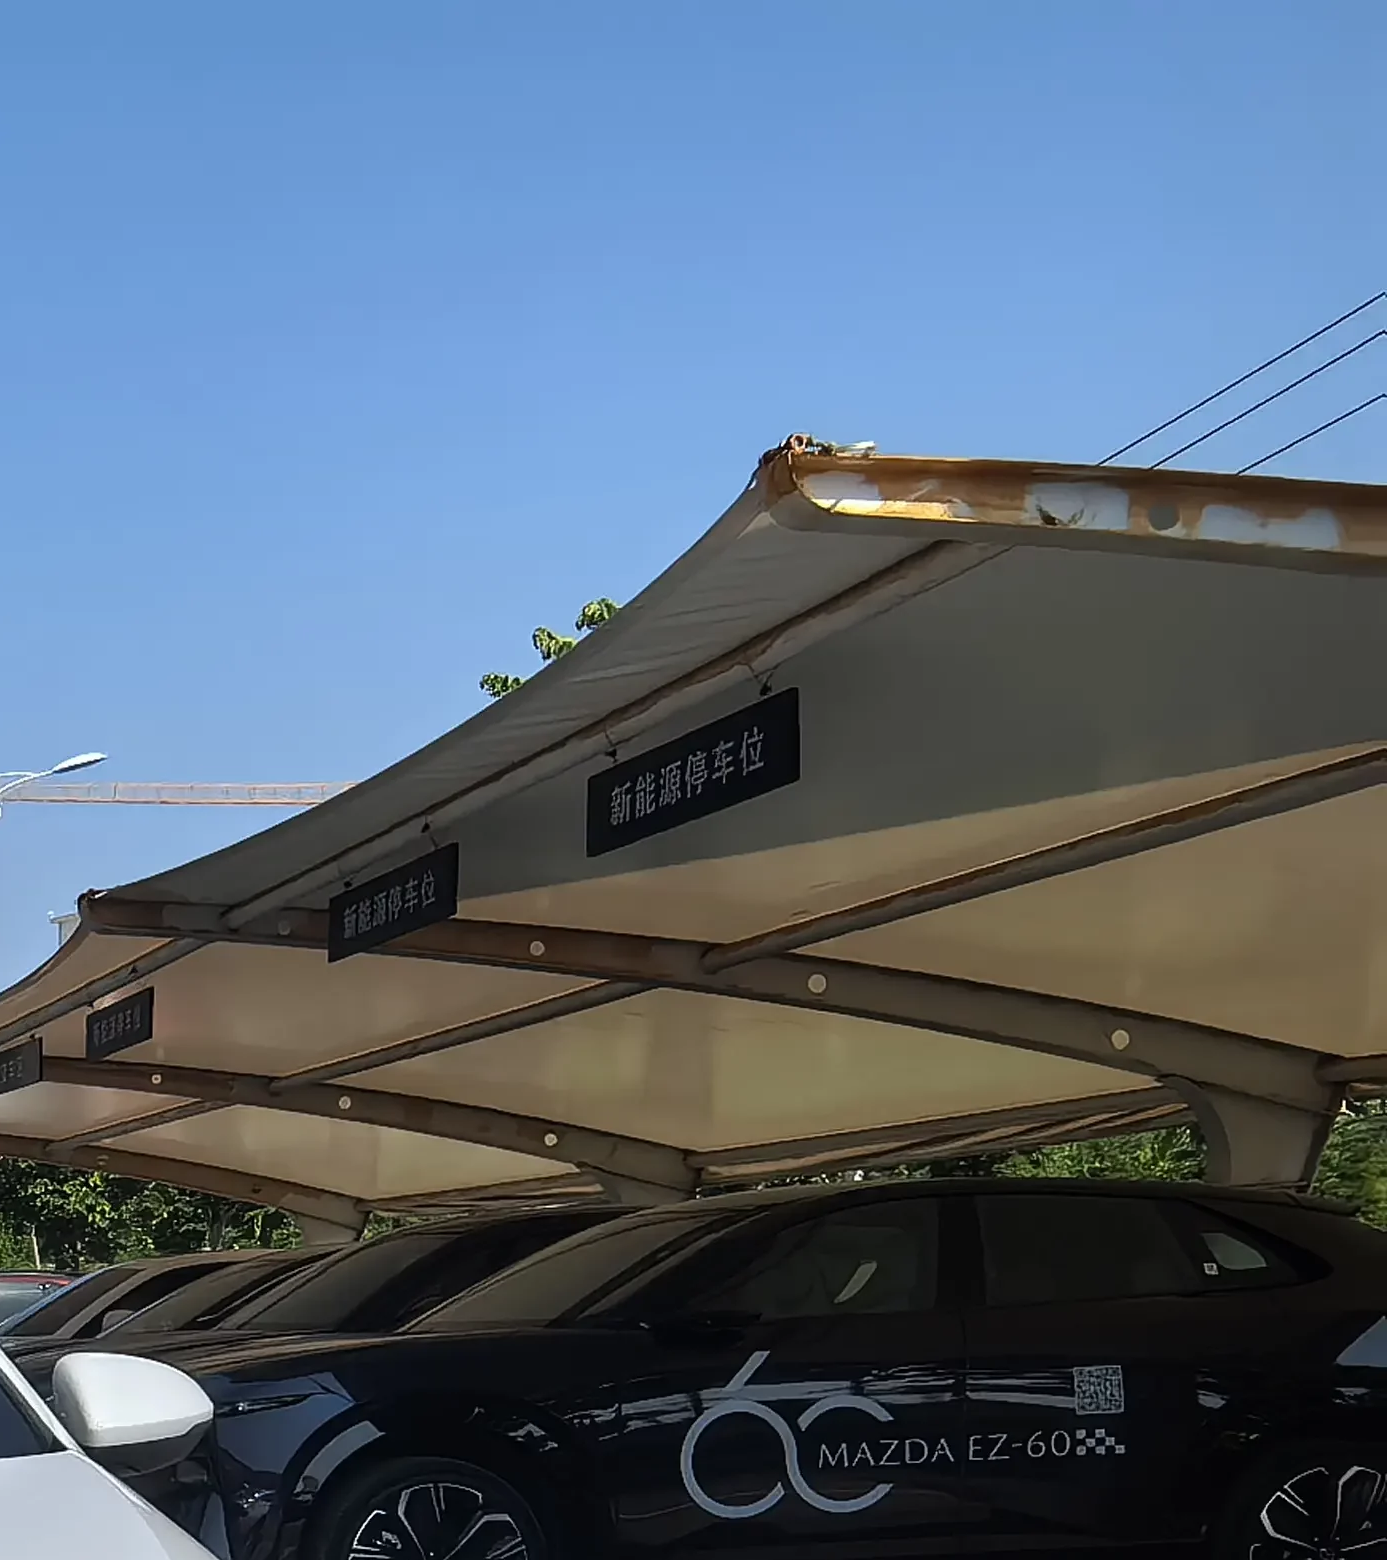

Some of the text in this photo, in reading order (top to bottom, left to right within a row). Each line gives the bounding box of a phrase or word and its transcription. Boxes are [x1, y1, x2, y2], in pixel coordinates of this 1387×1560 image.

[610, 726, 765, 825] 新能源停车位
[818, 1430, 1071, 1469] MAZDA EZ-60
